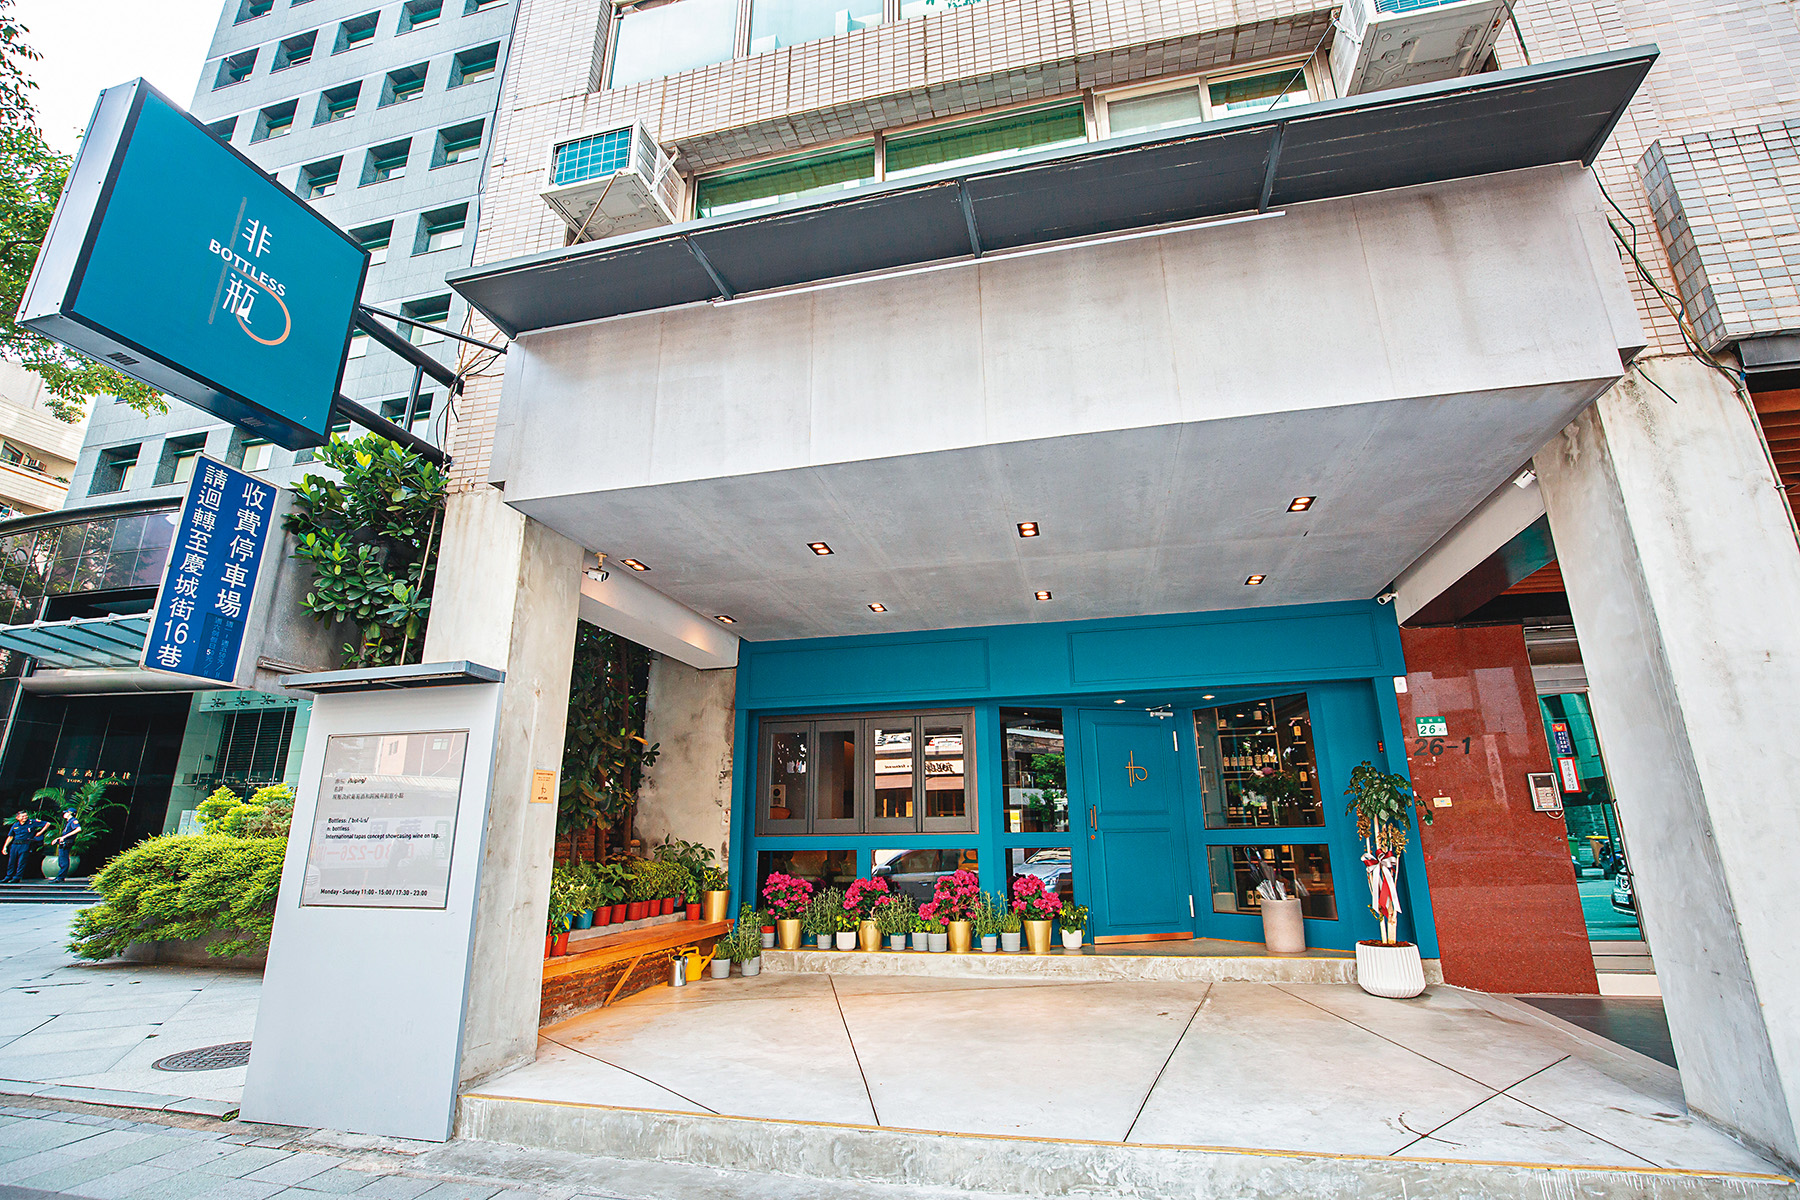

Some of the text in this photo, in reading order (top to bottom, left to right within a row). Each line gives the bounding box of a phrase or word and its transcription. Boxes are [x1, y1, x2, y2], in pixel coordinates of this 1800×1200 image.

[241, 218, 273, 258] 非
[208, 238, 287, 297] BOTTLESS
[156, 464, 229, 669] 請迴轉至慶城街16巷
[214, 482, 268, 619] 收費停車場
[1413, 736, 1472, 757] 26-1
[1420, 724, 1436, 735] 26
[320, 888, 339, 896] Monday
[342, 888, 360, 896] Sunday
